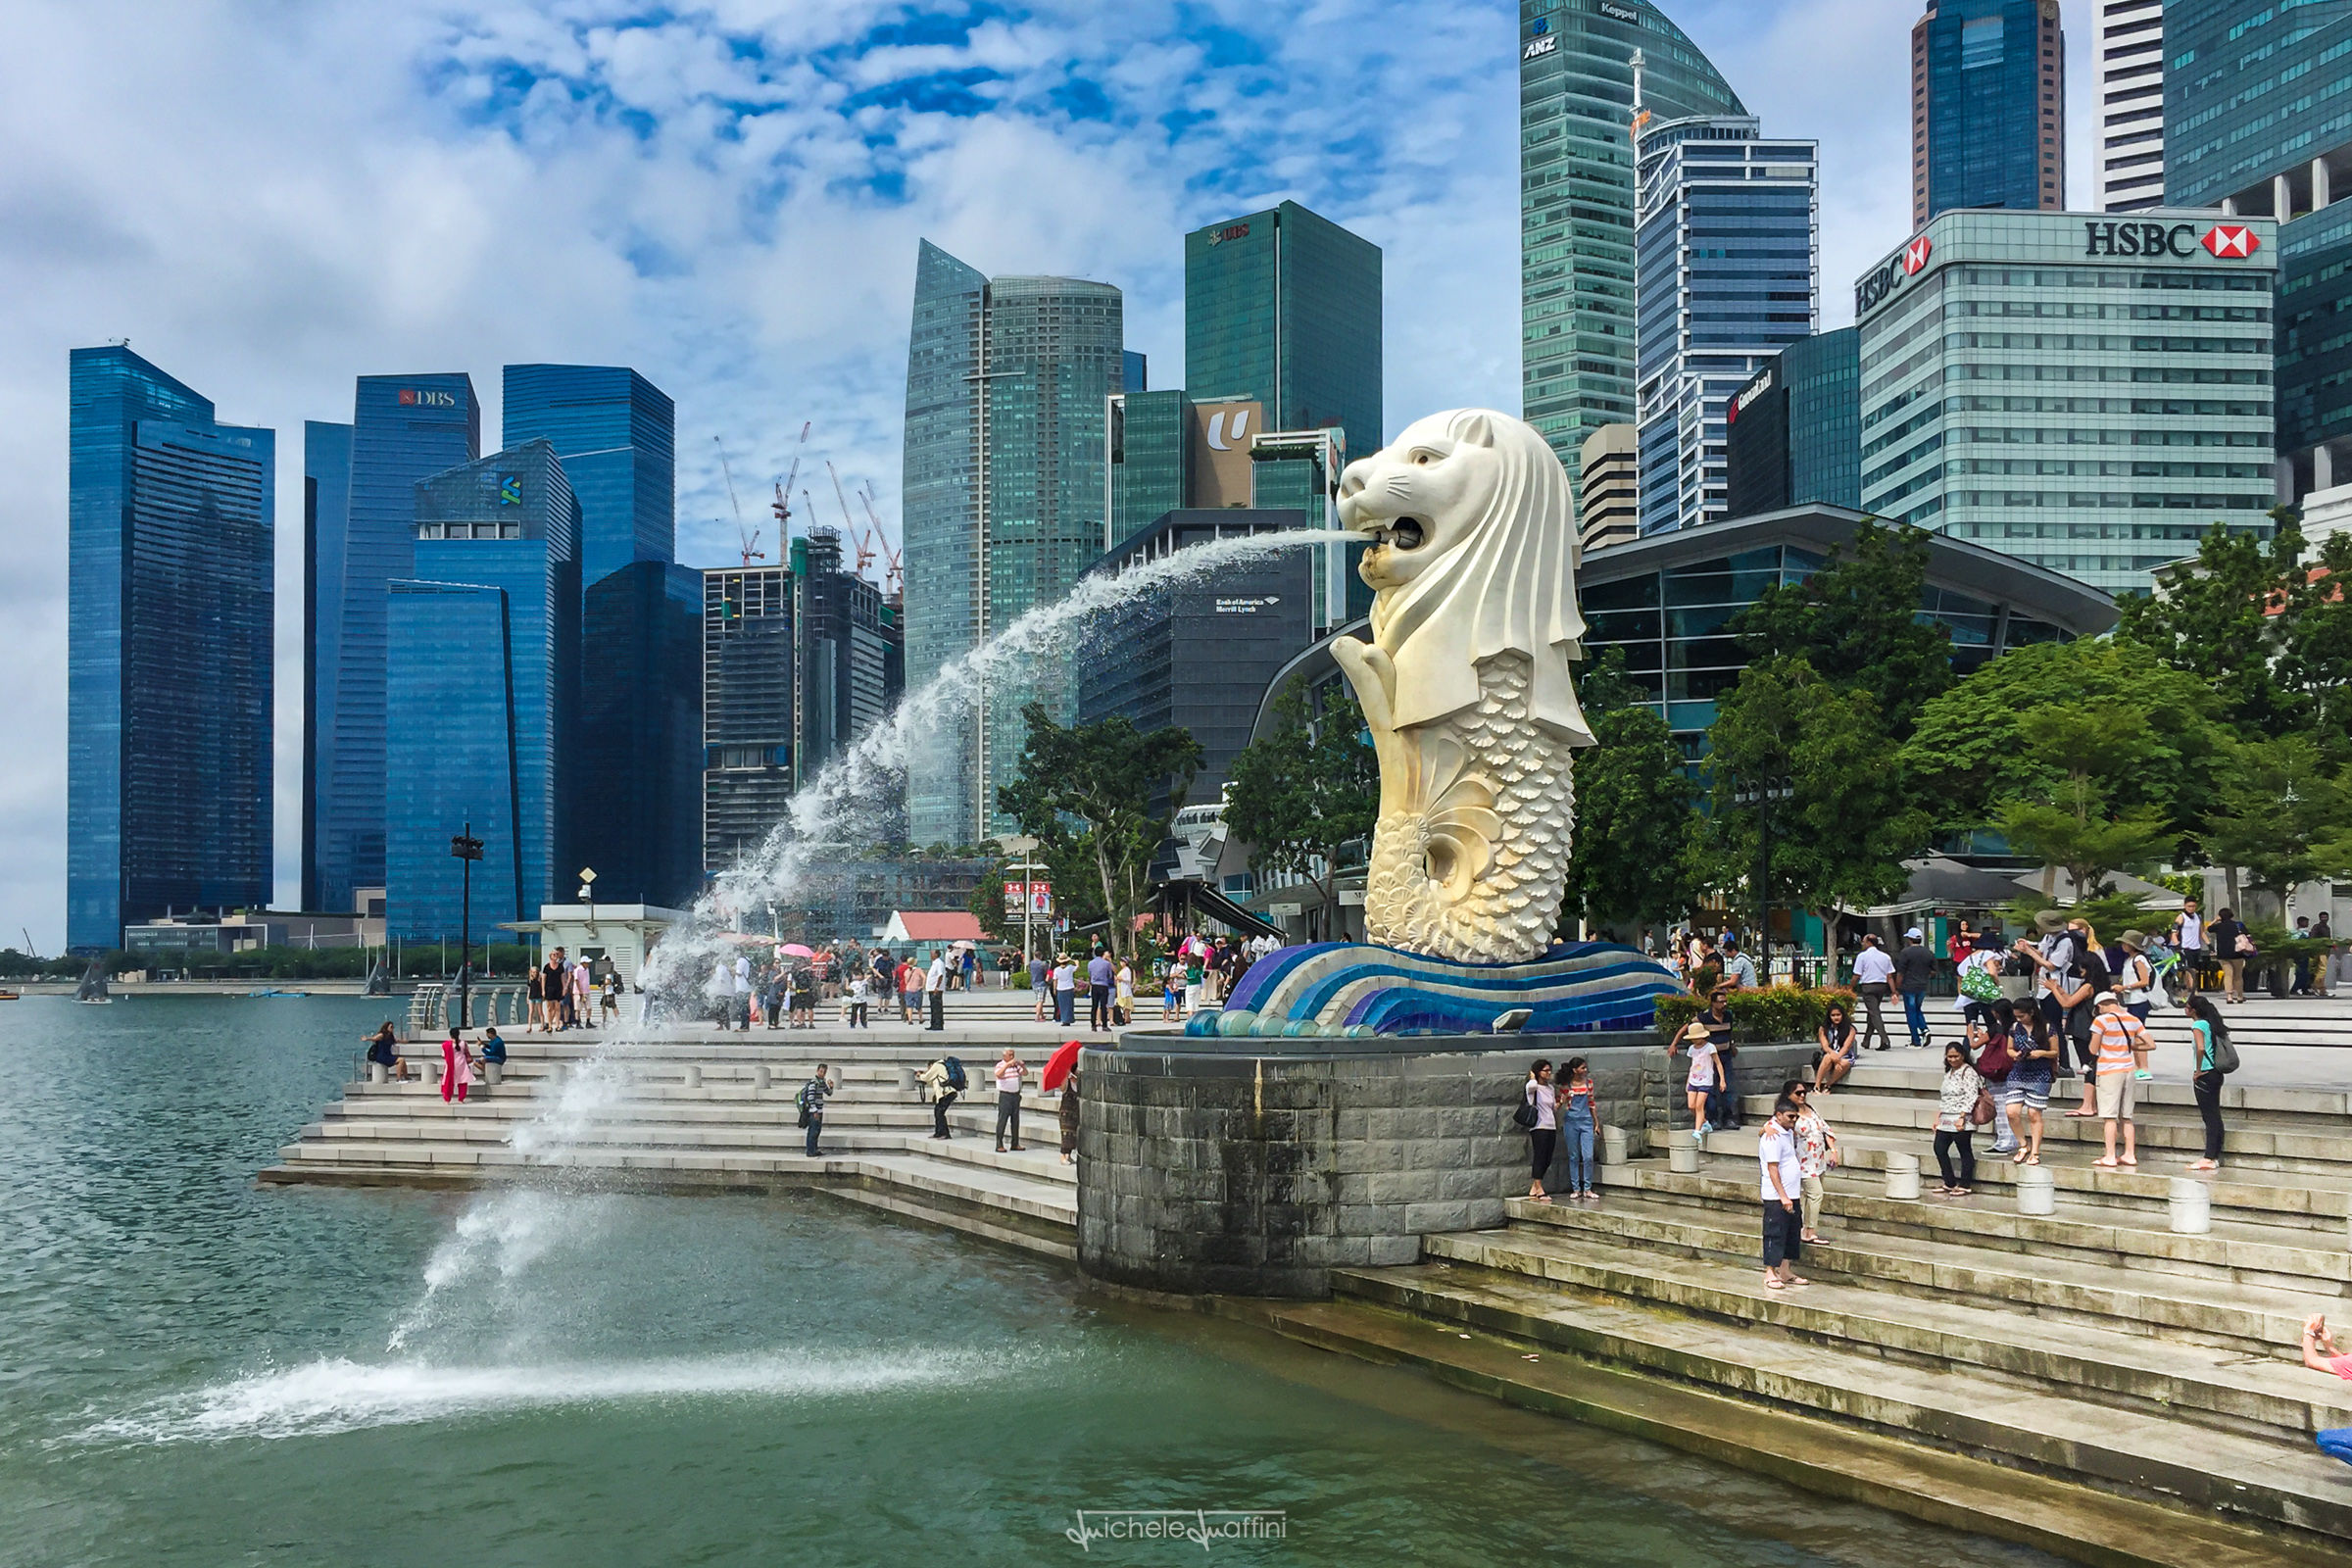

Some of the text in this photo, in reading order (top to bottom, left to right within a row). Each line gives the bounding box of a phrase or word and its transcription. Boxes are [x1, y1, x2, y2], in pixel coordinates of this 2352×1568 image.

[1601, 2, 1638, 21] Keppel
[1524, 36, 1555, 59] ANZ
[1223, 223, 1250, 241] UBS
[2085, 221, 2196, 258] HSBC
[1854, 253, 1903, 318] HSBC
[416, 390, 456, 407] DBS
